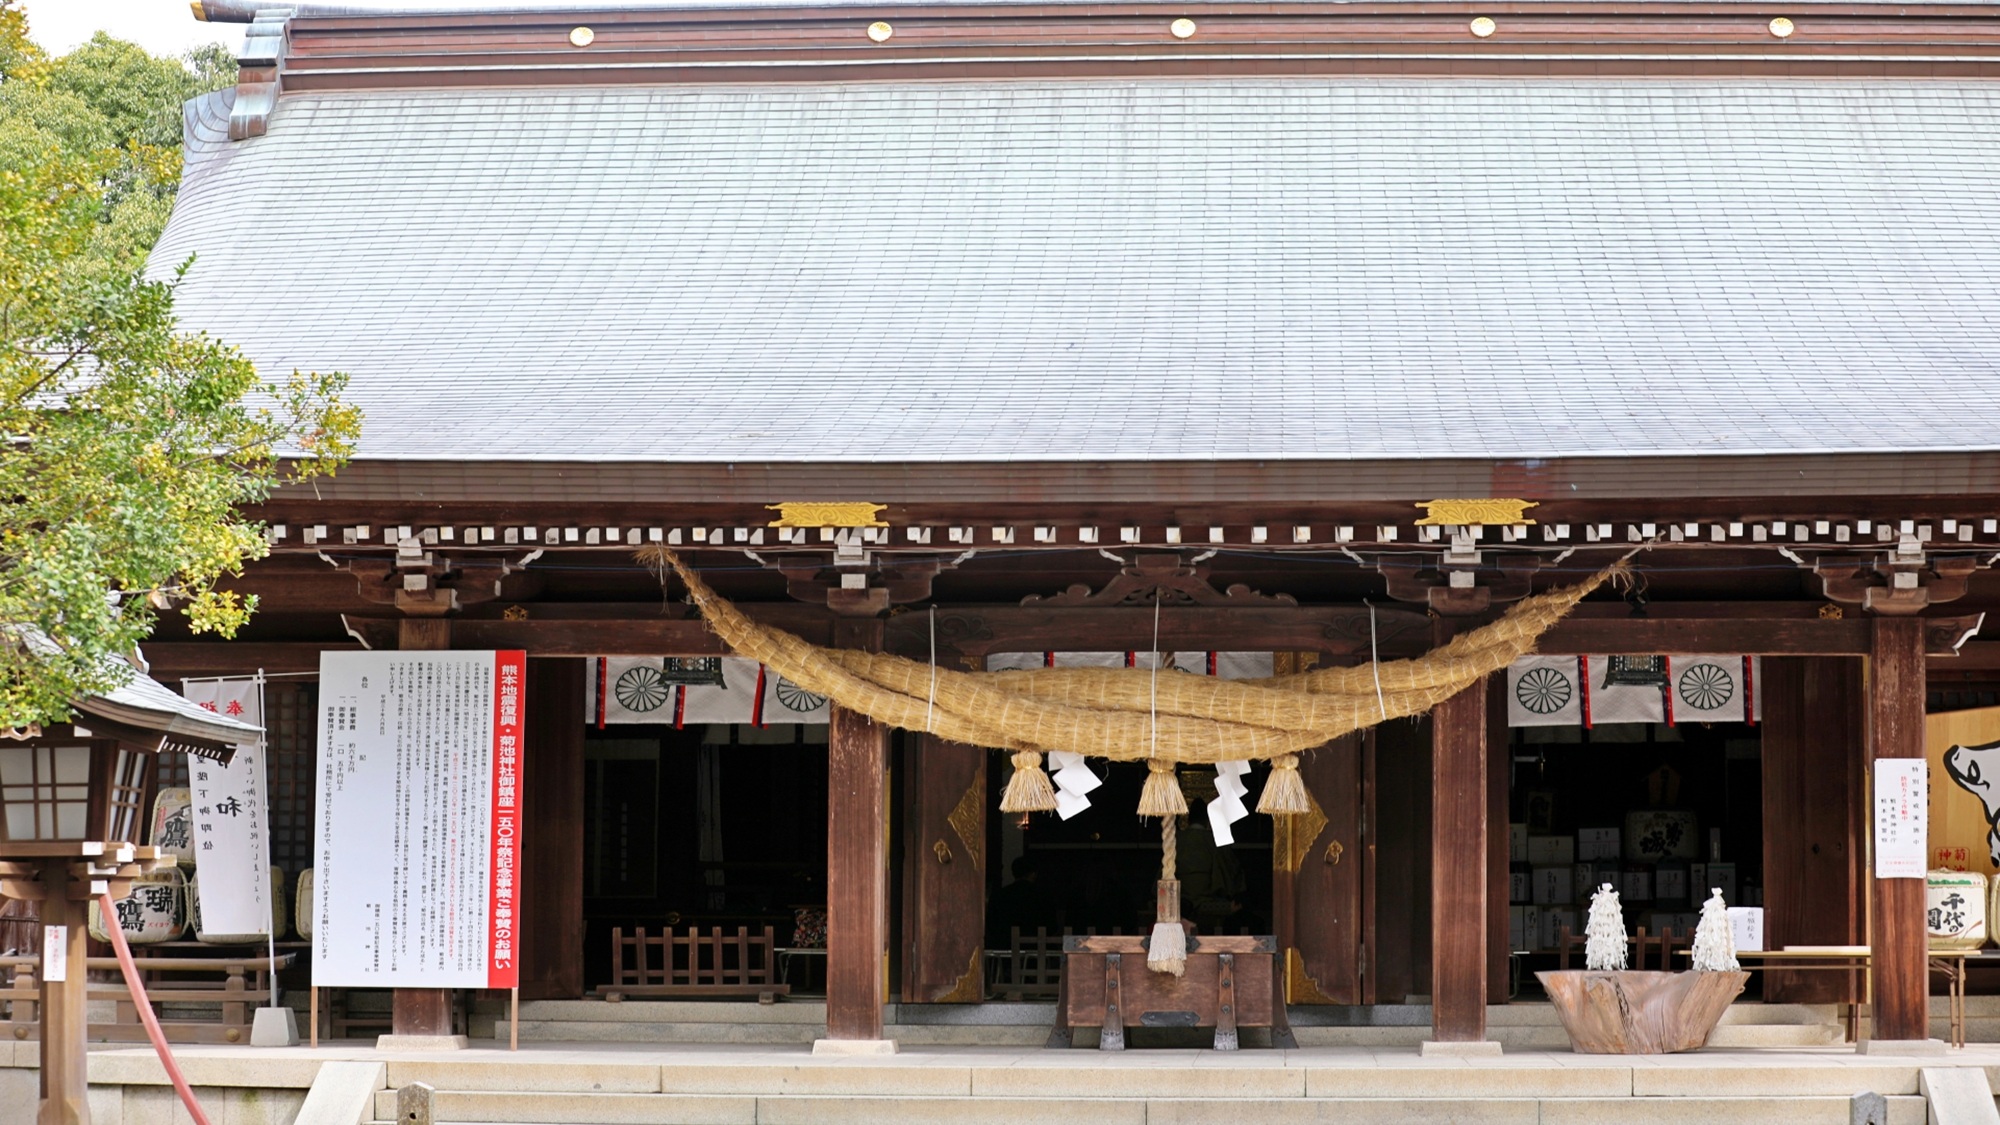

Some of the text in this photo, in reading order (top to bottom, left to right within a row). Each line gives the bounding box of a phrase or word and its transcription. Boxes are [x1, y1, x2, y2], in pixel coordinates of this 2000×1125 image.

[361, 676, 368, 689] 各位
[336, 761, 344, 791] 五千円以上
